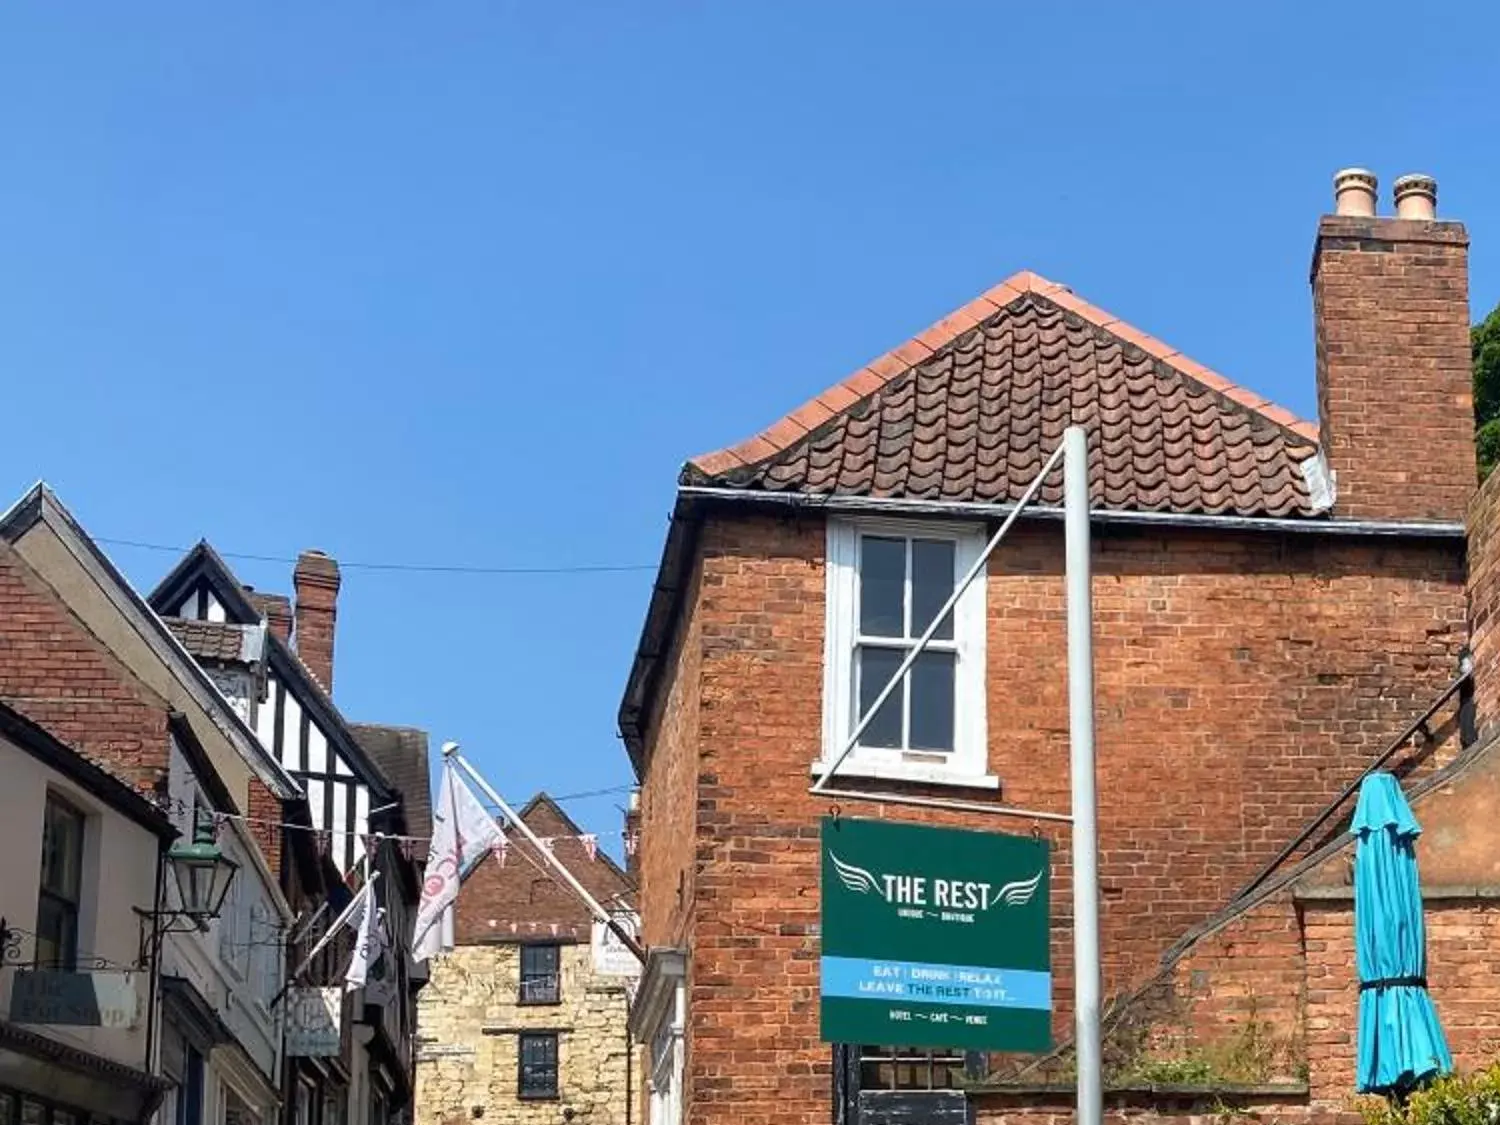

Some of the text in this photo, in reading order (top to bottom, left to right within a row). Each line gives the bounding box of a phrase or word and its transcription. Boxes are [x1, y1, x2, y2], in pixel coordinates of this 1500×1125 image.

[882, 874, 992, 911] THE REST
[874, 965, 1002, 984] EAT DRINK RELAX
[858, 981, 903, 994] LEAVE
[907, 983, 935, 996] THE
[936, 985, 970, 998] REST
